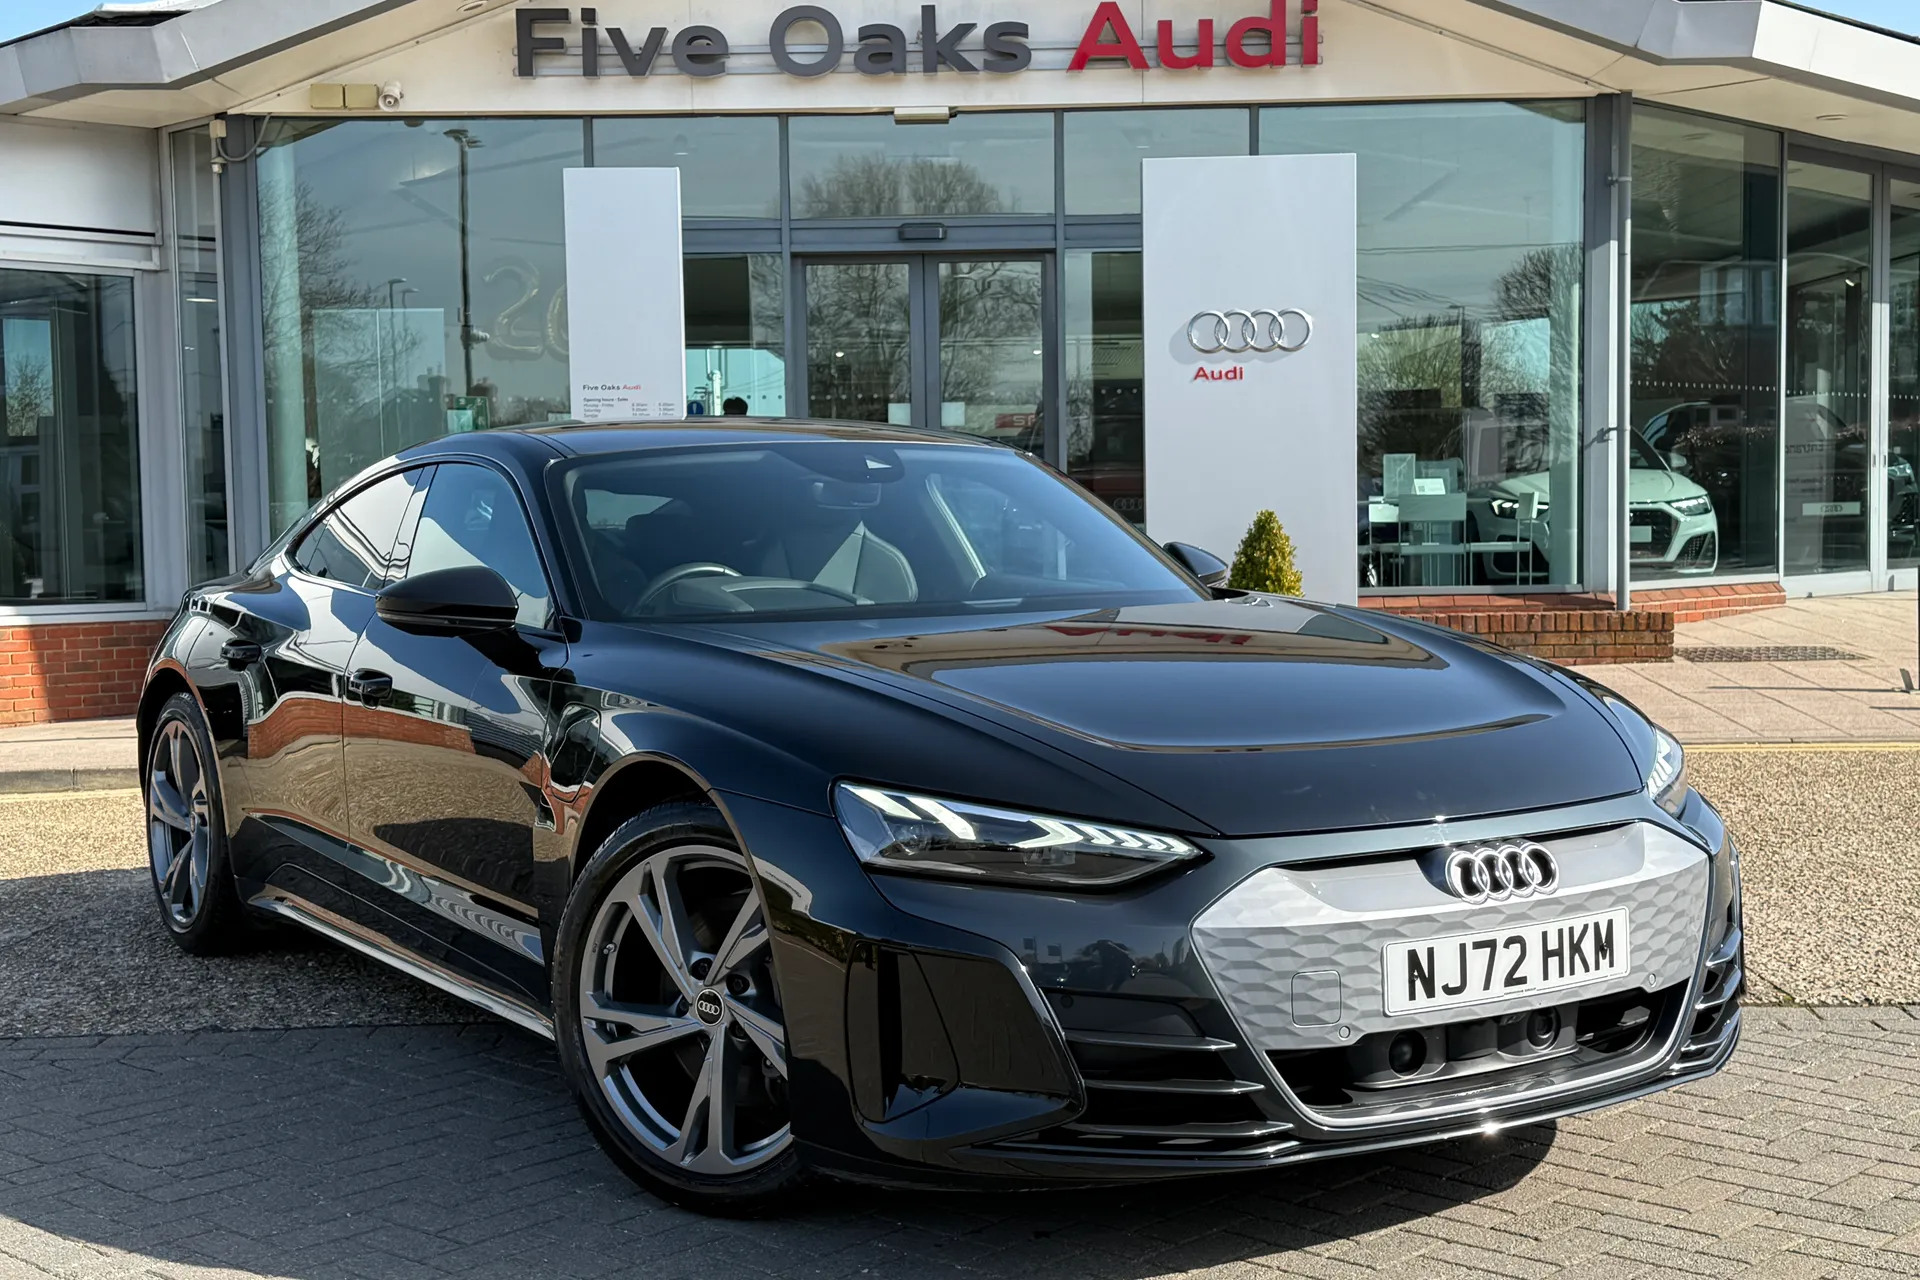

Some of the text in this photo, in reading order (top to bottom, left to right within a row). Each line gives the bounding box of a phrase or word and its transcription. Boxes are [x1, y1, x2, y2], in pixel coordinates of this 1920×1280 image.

[515, 0, 1319, 79] Five Oaks Audi
[1193, 365, 1245, 381] Audi
[1406, 918, 1615, 1002] NJ72 HKM
